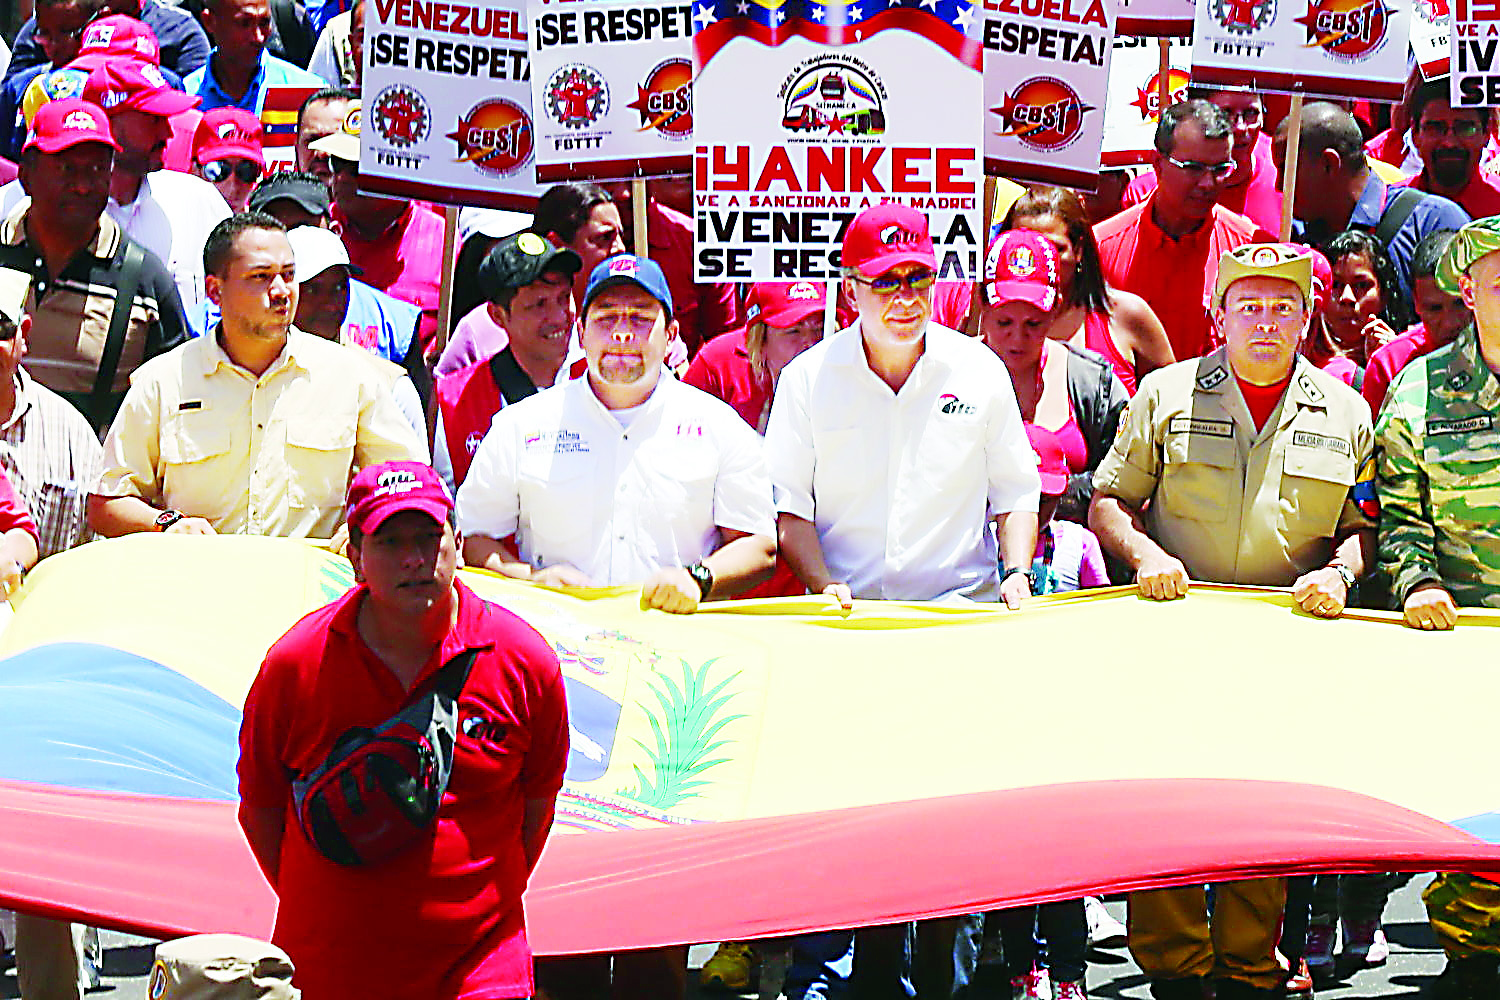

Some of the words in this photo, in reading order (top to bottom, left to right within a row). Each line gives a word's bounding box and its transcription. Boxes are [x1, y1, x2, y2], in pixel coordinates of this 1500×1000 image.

[536, 9, 586, 49] ¡SE
[589, 5, 693, 44] RESPET
[983, 18, 1106, 67] ESPETA!
[1456, 22, 1482, 35] VE
[1488, 23, 1498, 35] A
[695, 145, 976, 195] ¡YANKEE
[697, 194, 721, 207] VE
[727, 195, 739, 207] A
[749, 195, 851, 209] SANCIONAR
[860, 196, 870, 207] A
[697, 210, 977, 245] ¡VENEZLA
[698, 248, 753, 277] SE
[773, 248, 976, 280] RESA!
